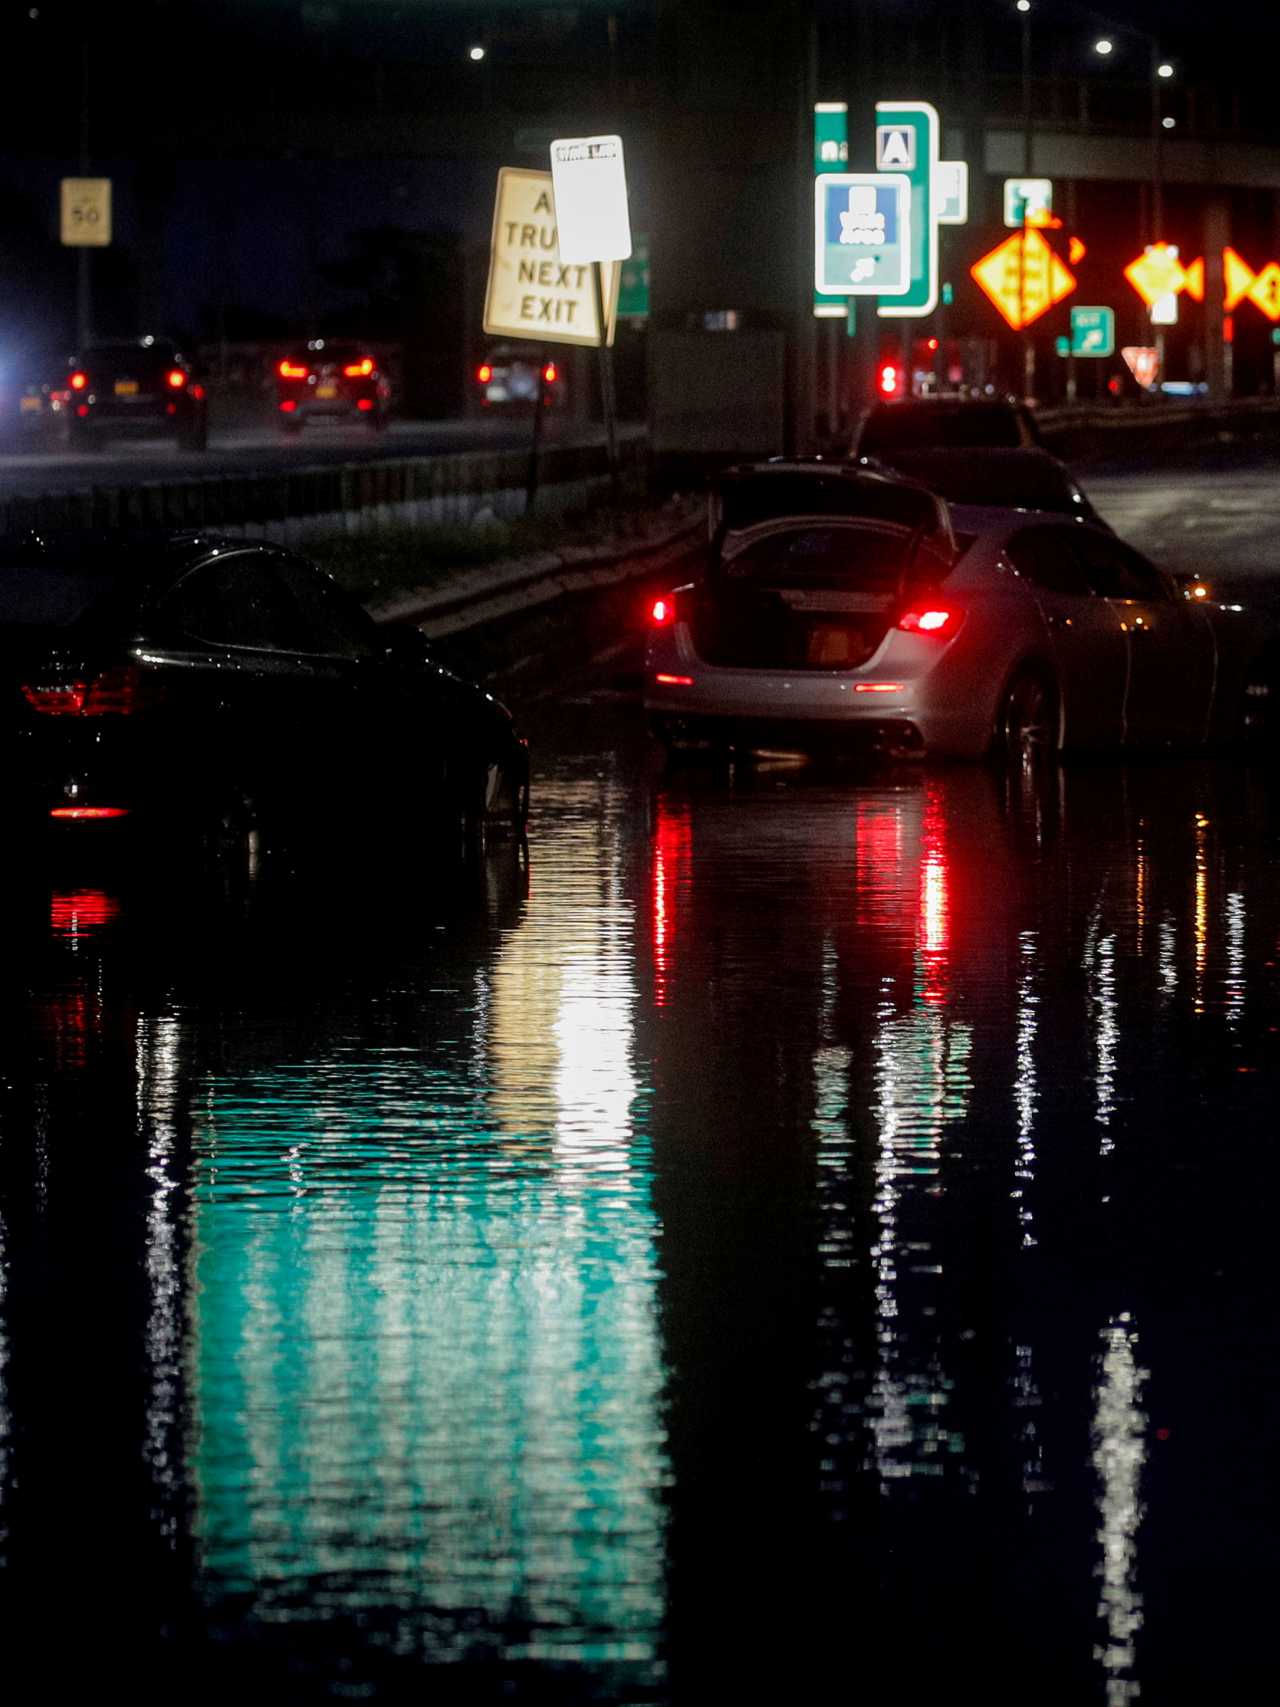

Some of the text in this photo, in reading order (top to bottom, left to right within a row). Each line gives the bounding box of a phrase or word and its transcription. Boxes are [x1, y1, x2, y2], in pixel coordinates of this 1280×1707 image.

[504, 221, 559, 251] TRU
[517, 258, 589, 290] NEXT
[520, 295, 579, 324] EXIT
